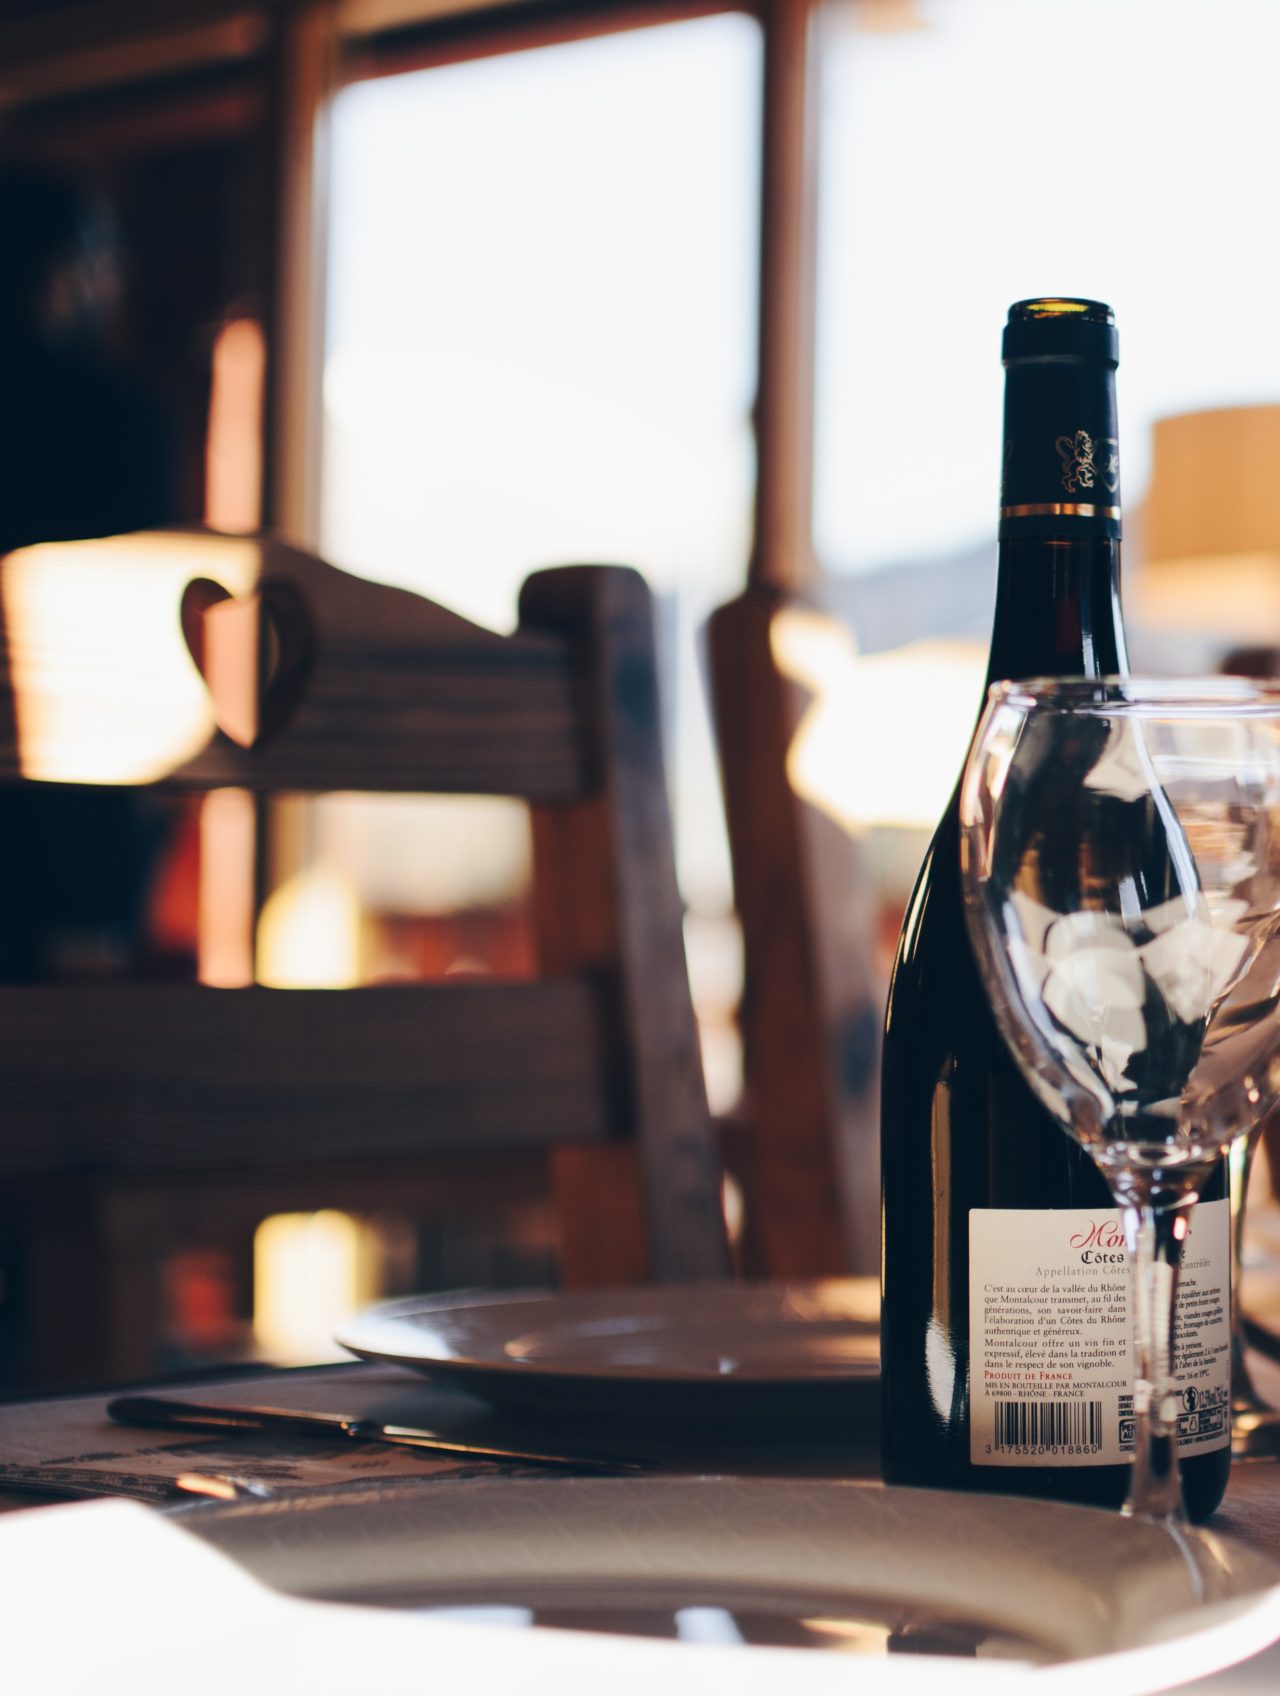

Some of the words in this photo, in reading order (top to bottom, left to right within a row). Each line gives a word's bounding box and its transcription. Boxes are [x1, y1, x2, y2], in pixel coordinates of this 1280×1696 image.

[1080, 1250, 1125, 1264] Côtes
[1035, 1266, 1098, 1278] Appellation
[984, 1284, 1003, 1293] C'est
[1040, 1284, 1050, 1293] de
[1052, 1284, 1060, 1293] la
[1062, 1284, 1085, 1293] vallée
[1088, 1284, 1098, 1292] du
[1101, 1283, 1126, 1292] Rhône
[1000, 1295, 1048, 1303] Montalcour
[1050, 1296, 1089, 1304] transmet,
[1103, 1294, 1111, 1302] fil
[1113, 1294, 1126, 1302] des
[984, 1306, 1032, 1315] générations,
[1057, 1305, 1103, 1314] savoir-faire
[1108, 1305, 1126, 1313] dans
[984, 1316, 1034, 1324] l'élaboration
[1060, 1316, 1083, 1324] Côtes
[1086, 1316, 1097, 1324] du
[1101, 1315, 1126, 1324] Rhône
[984, 1326, 1031, 1337] authentique
[1043, 1328, 1083, 1337] généreux.
[984, 1339, 1038, 1347] Montalcour
[1042, 1339, 1064, 1347] offre
[1084, 1338, 1098, 1346] vin
[1103, 1338, 1114, 1346] fin
[984, 1349, 1023, 1359] expressif,
[1025, 1349, 1046, 1358] élevé
[1048, 1349, 1068, 1358] dans
[1071, 1349, 1078, 1358] la
[1081, 1349, 1116, 1357] tradition
[984, 1360, 1003, 1368] dans
[1006, 1360, 1013, 1368] le
[1015, 1361, 1044, 1371] respect
[1047, 1360, 1056, 1368] de
[1077, 1360, 1114, 1371] vignoble.
[1072, 1380, 1128, 1389] MONTALCOUR
[1018, 1389, 1046, 1397] RHÔNE
[985, 1445, 992, 1454] 3
[1000, 1445, 1045, 1454] 175520
[1052, 1445, 1098, 1454] 018860
